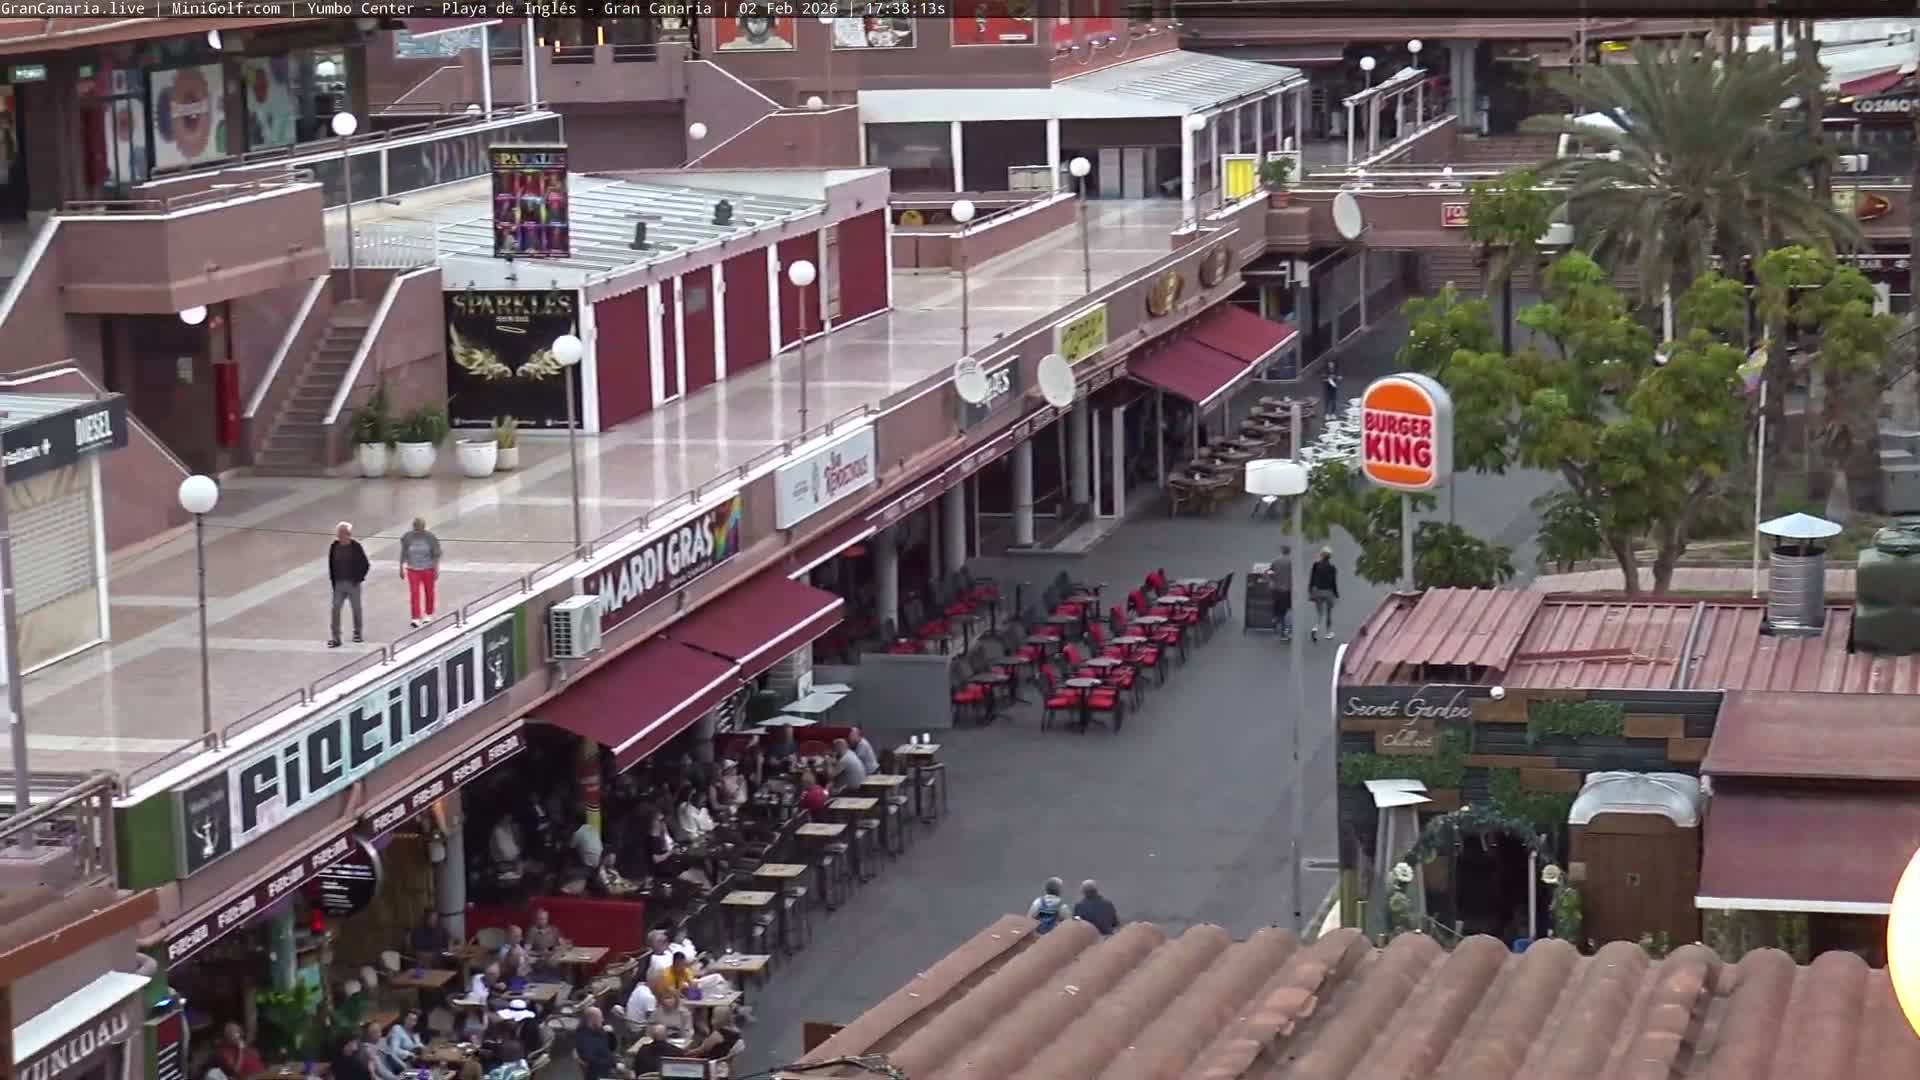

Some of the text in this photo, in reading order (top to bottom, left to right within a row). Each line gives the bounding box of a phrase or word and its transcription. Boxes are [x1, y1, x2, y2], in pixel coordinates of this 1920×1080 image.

[452, 294, 573, 316] SPARKLES
[75, 410, 113, 446] DIESEL
[1365, 412, 1431, 439] BURGER
[1365, 433, 1432, 468] KING
[599, 543, 665, 616] MARDI
[666, 514, 715, 576] GRAS
[1343, 696, 1400, 718] Secret
